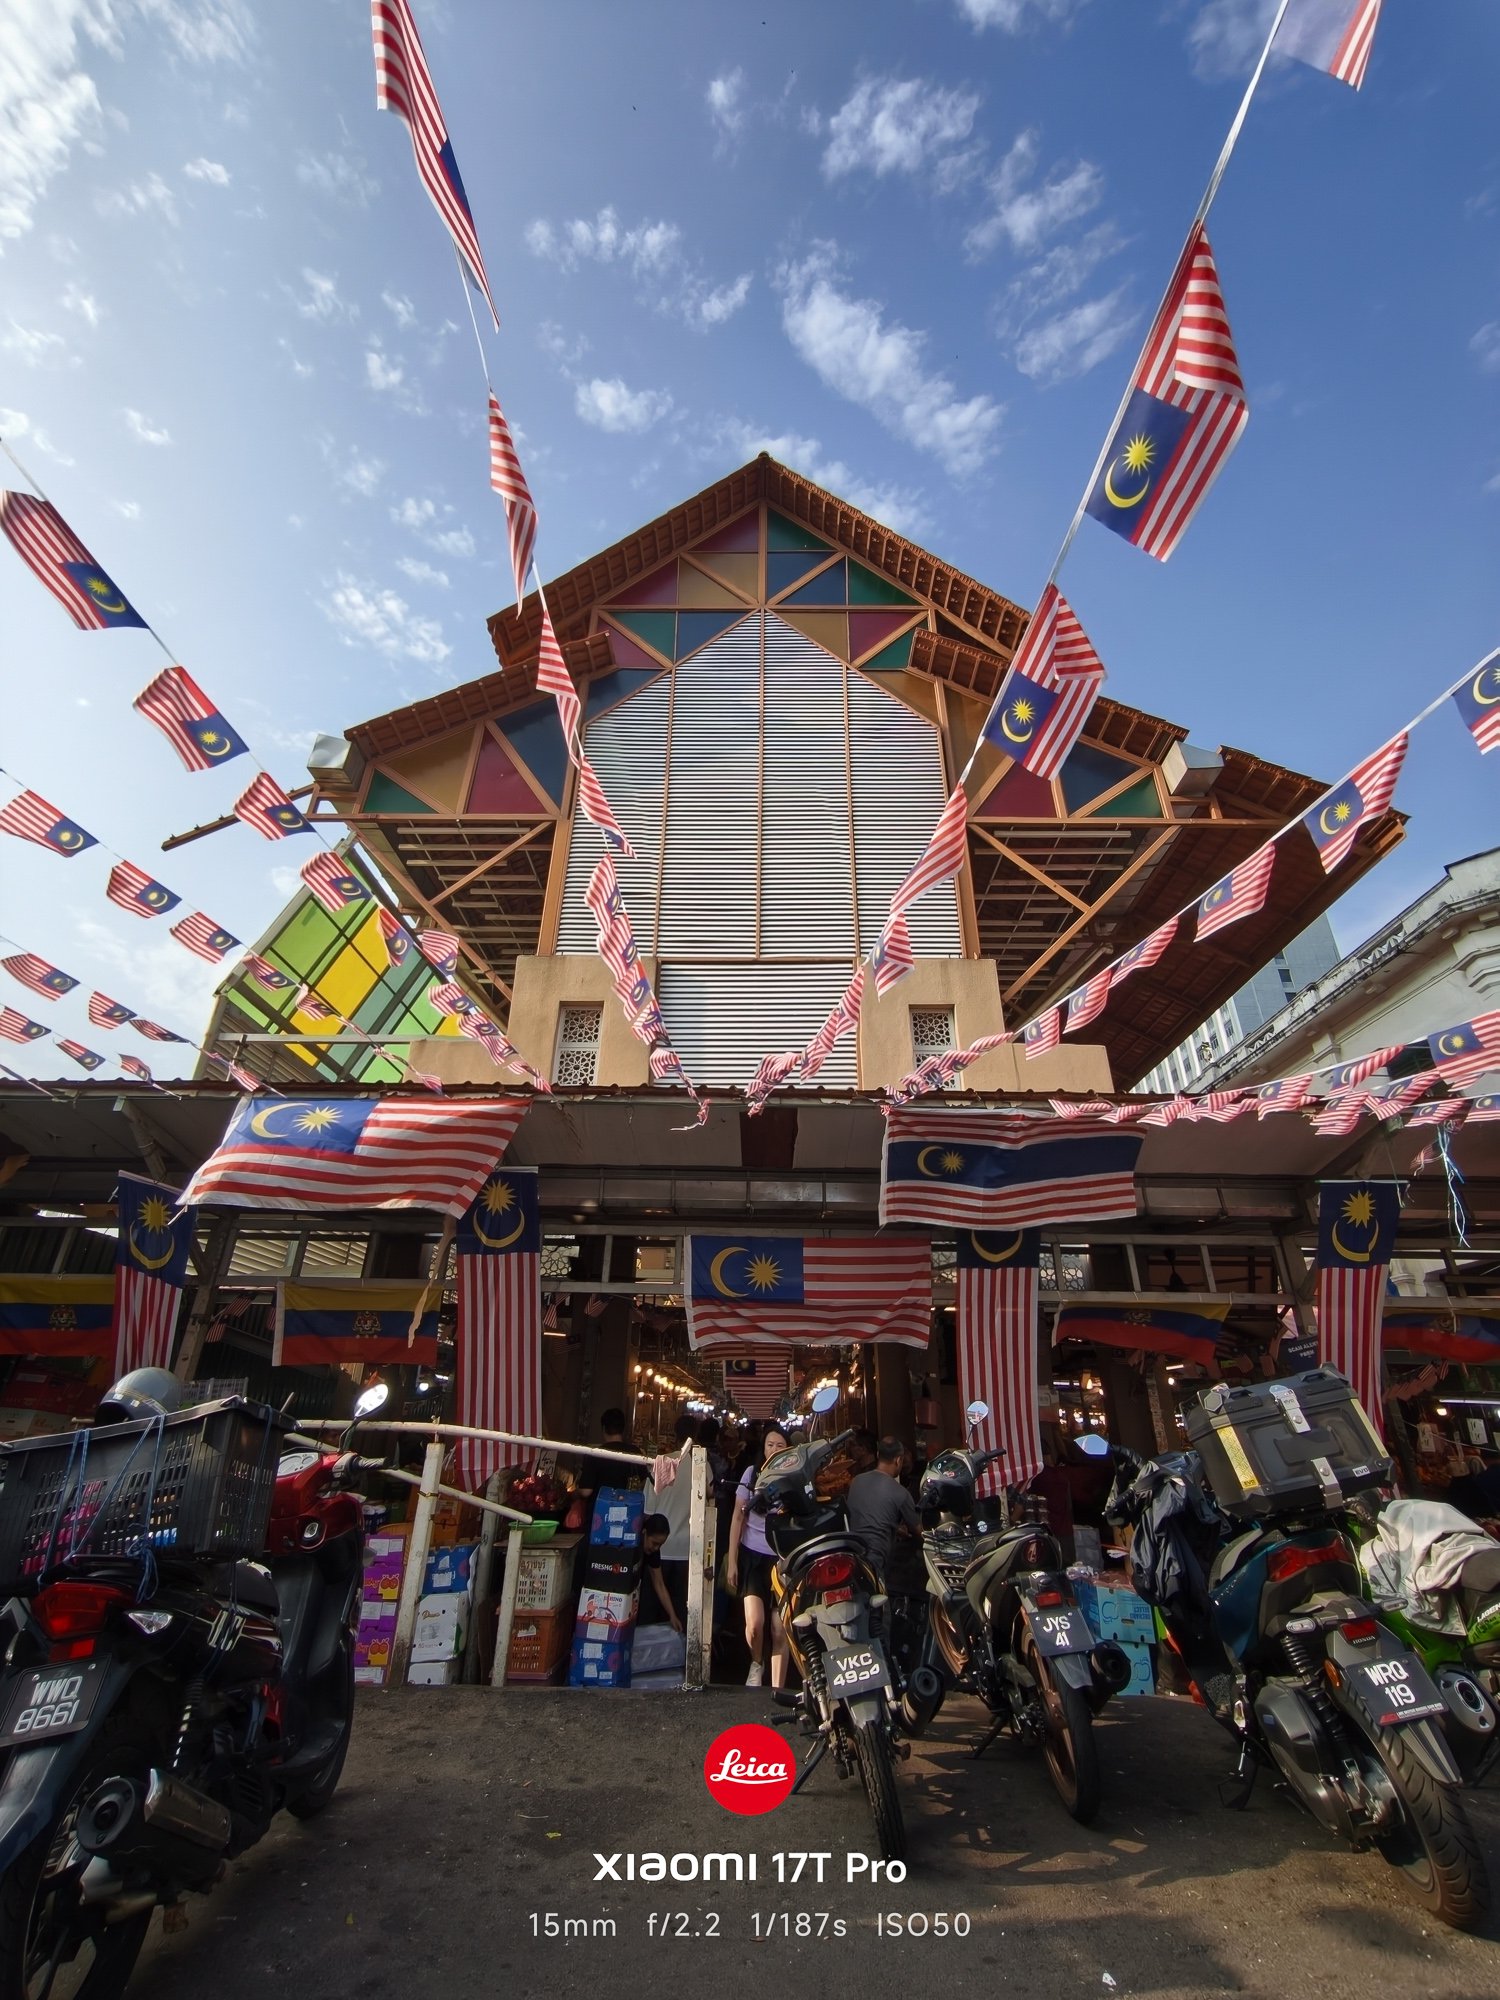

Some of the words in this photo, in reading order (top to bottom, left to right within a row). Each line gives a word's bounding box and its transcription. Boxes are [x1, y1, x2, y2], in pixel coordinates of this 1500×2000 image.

[1042, 1615, 1071, 1633] JYS
[1055, 1631, 1070, 1647] 41
[1352, 1635, 1376, 1645] HONDA
[836, 1652, 873, 1672] VKC
[1363, 1660, 1410, 1687] WRQ
[29, 1675, 83, 1707] WWQ
[1384, 1683, 1416, 1708] 119
[13, 1699, 81, 1734] 8661
